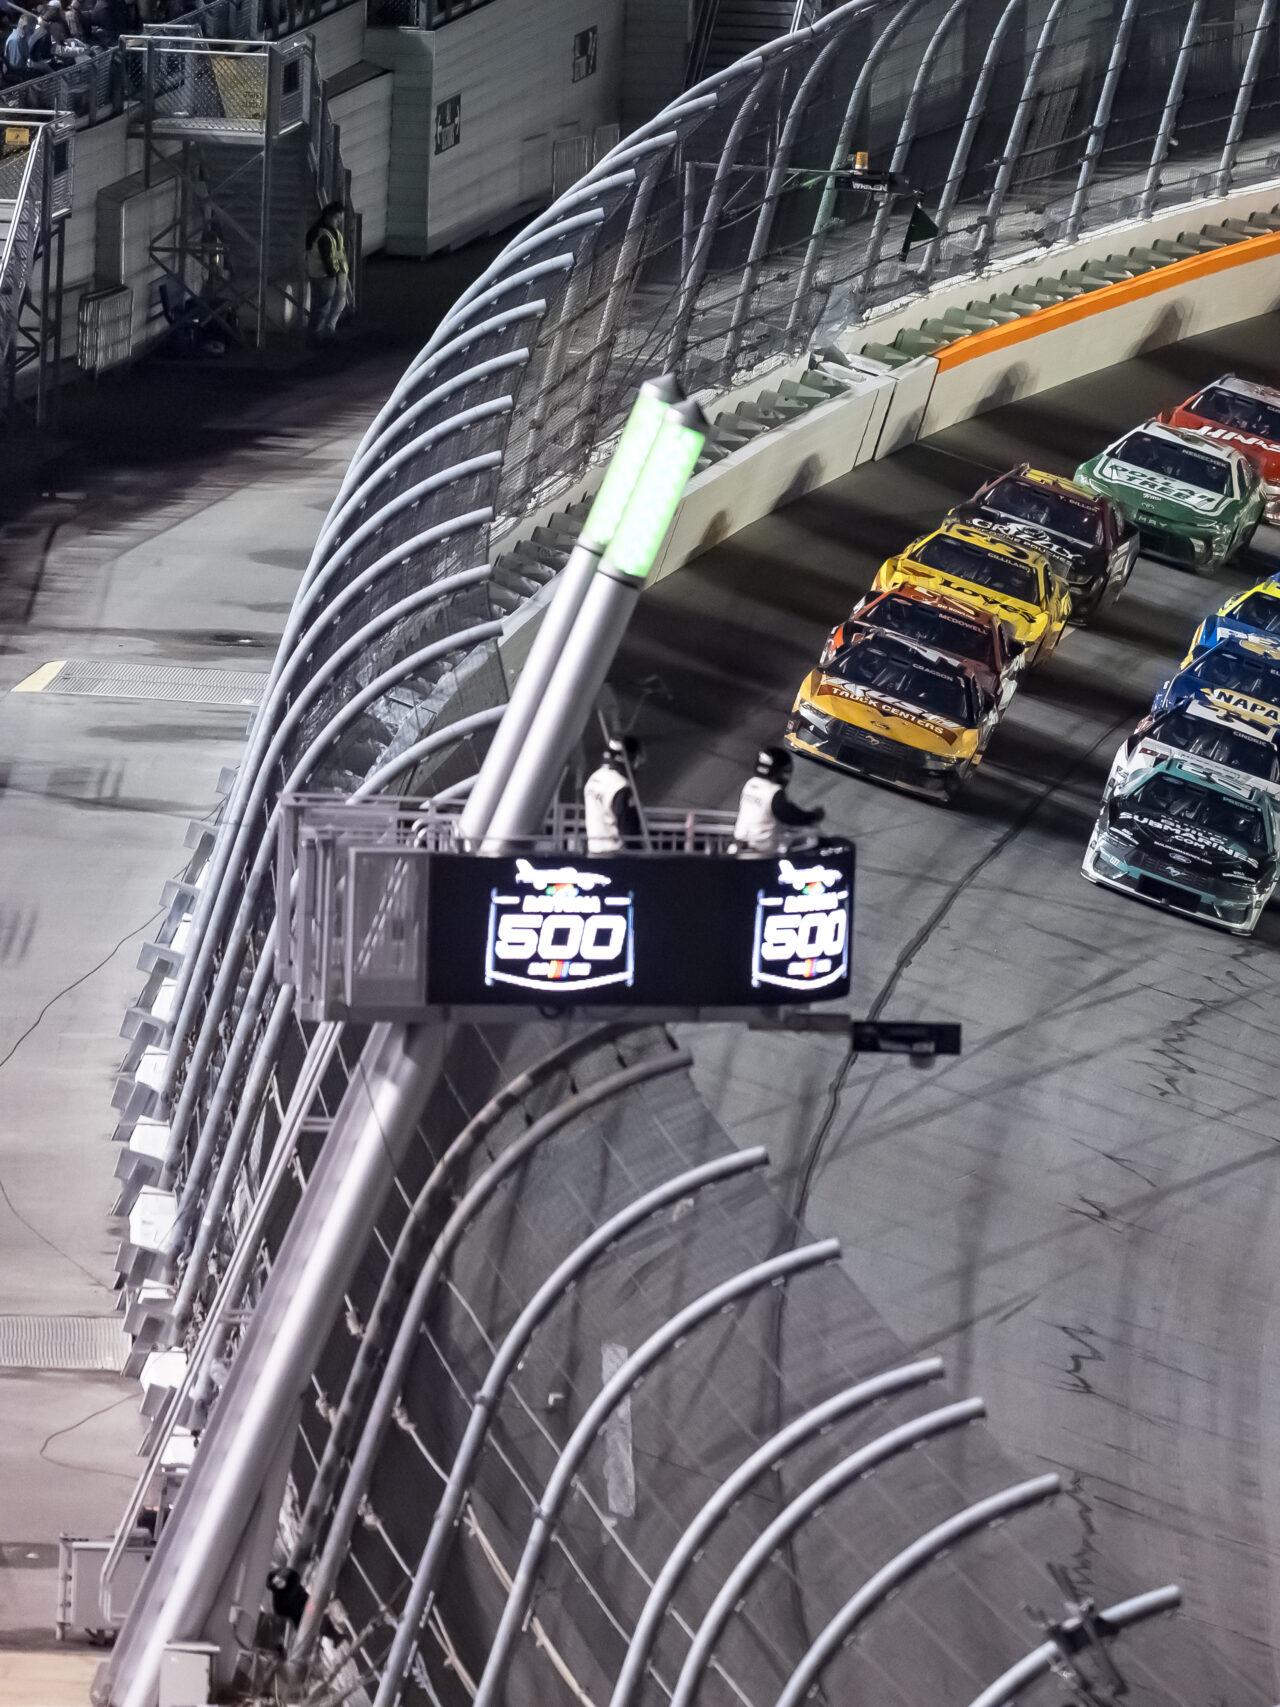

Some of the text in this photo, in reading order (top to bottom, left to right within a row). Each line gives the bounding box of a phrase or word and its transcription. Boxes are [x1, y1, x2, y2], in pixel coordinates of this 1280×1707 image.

[1125, 475, 1193, 501] TREE
[971, 517, 1083, 560] GRIZZLY
[831, 687, 945, 735] TRUCK CENTERS
[1215, 690, 1280, 722] NAPA
[1118, 811, 1260, 869] SUBMARINES
[494, 913, 628, 961] 500
[760, 908, 848, 961] 500
